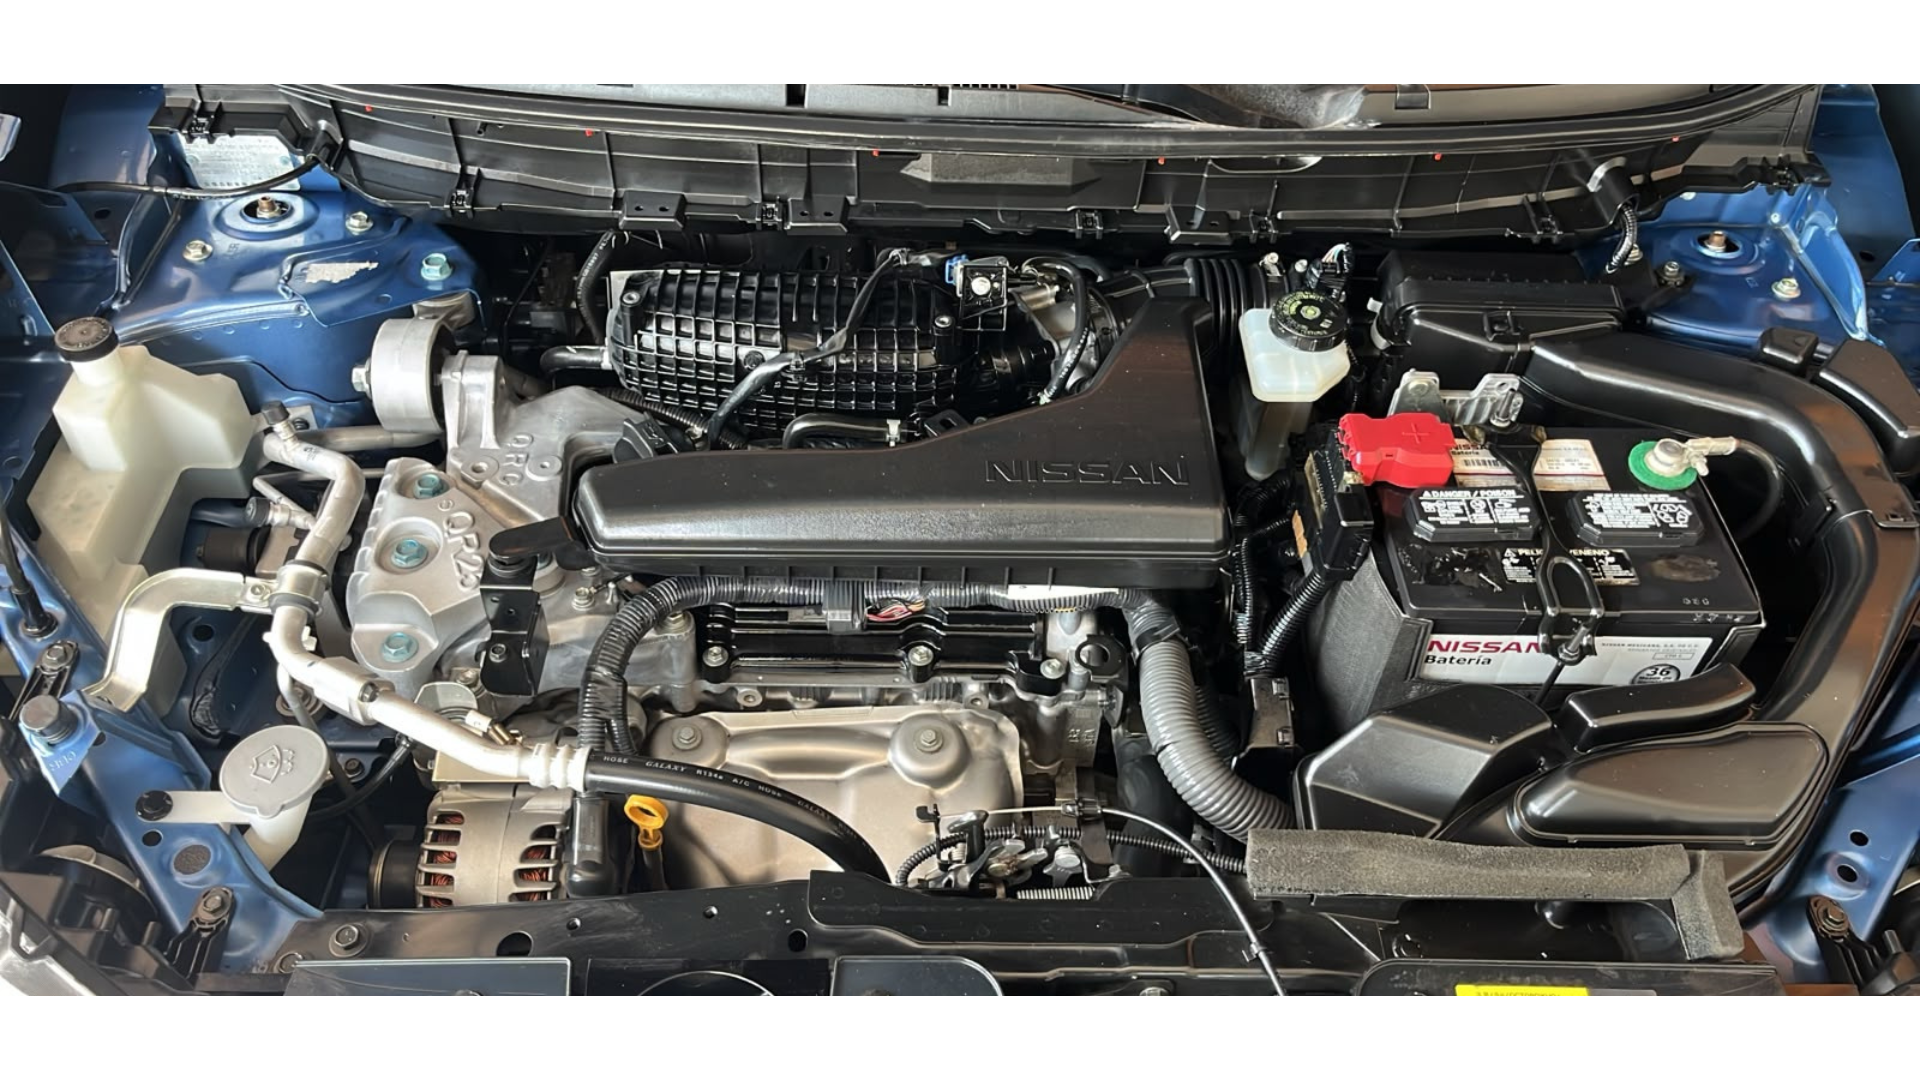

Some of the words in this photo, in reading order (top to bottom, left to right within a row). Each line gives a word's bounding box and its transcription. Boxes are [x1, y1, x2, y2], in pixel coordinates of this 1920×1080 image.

[984, 460, 1190, 486] NISSAN
[1424, 655, 1493, 666] Batería
[1645, 667, 1672, 677] 36
[603, 755, 629, 764] HOSE
[645, 760, 688, 772] GALAXY
